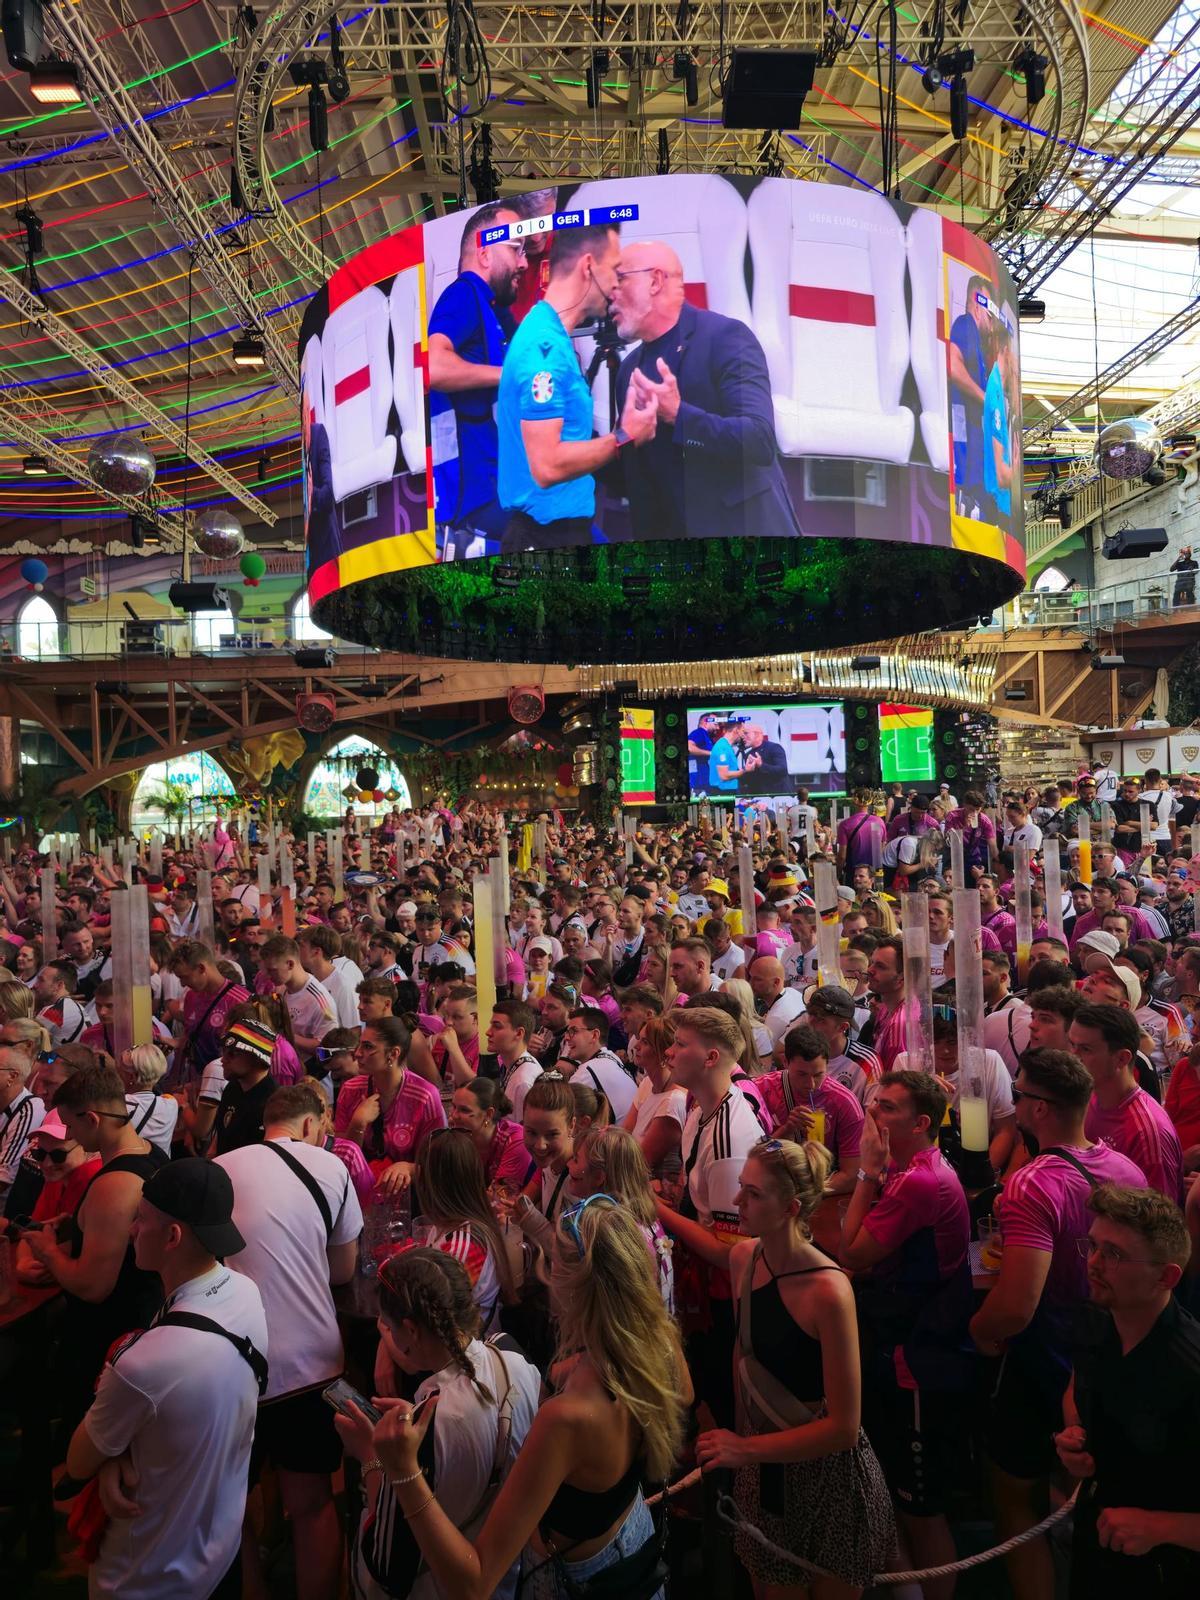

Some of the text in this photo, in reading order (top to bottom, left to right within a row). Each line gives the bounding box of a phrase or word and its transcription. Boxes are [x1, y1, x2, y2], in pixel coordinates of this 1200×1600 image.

[485, 208, 633, 242] ESP 0 0 GER 6:48
[798, 814, 807, 829] 8
